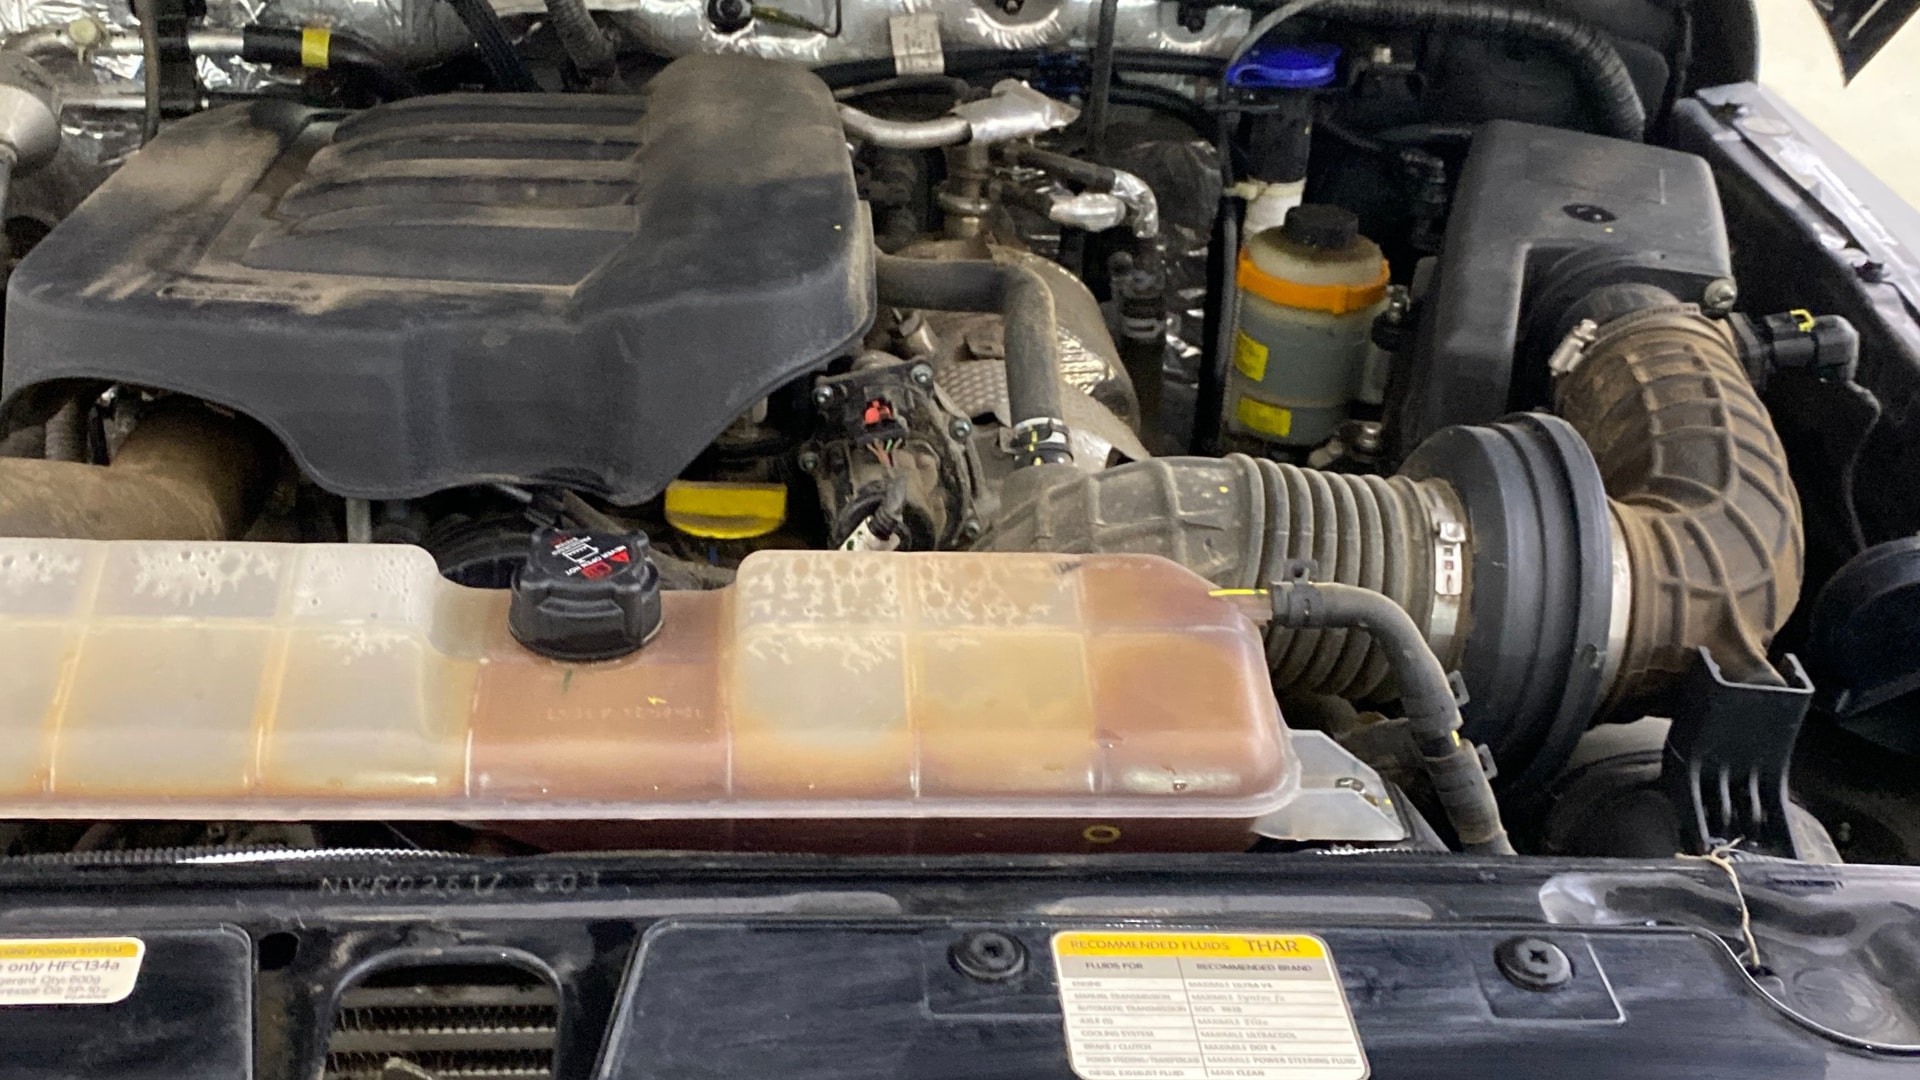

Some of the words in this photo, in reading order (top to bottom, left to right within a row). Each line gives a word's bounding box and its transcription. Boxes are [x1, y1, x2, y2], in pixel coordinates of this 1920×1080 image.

[1070, 940, 1179, 950] RECOMMENDED
[1182, 941, 1230, 951] FLUIDS
[1244, 939, 1300, 953] THAR
[8, 961, 44, 973] only
[47, 960, 120, 972] HFC134a
[1196, 963, 1276, 971] RECOMMENDED
[1278, 964, 1313, 972] BRAND
